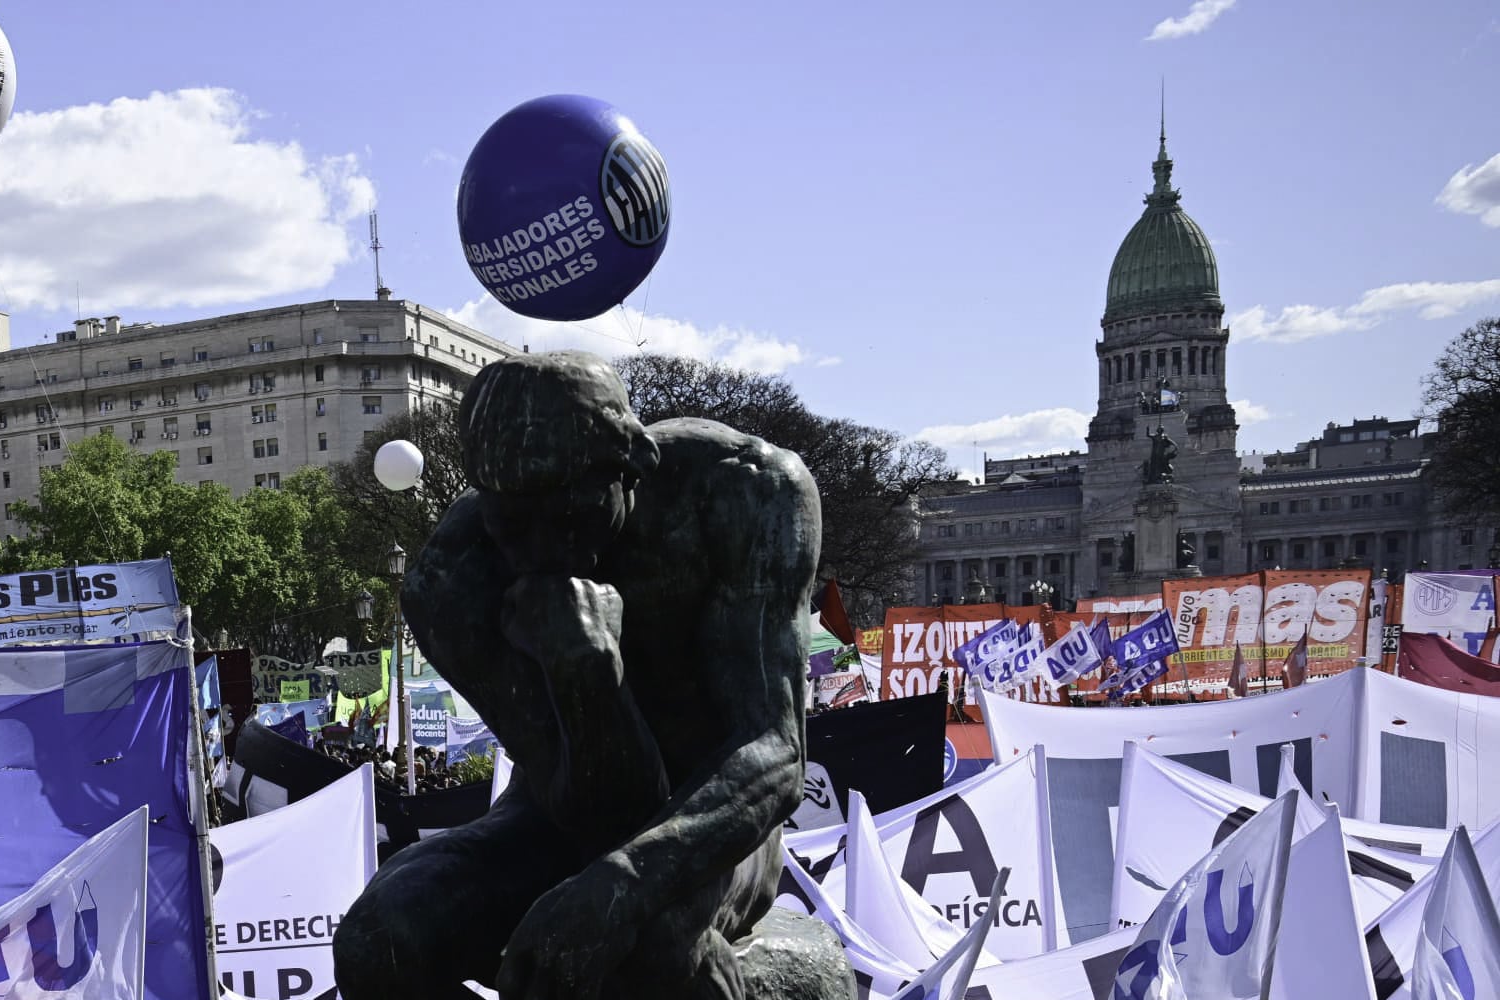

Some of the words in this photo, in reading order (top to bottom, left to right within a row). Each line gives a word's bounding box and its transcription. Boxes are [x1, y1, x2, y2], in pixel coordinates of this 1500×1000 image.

[466, 195, 594, 264] ABAJADORES
[475, 218, 606, 284] VERSIDADES
[1177, 594, 1195, 644] nuevo
[1194, 580, 1366, 646] mas
[1226, 646, 1285, 660] SCIALISMO
[1306, 644, 1347, 658] ARBARIE
